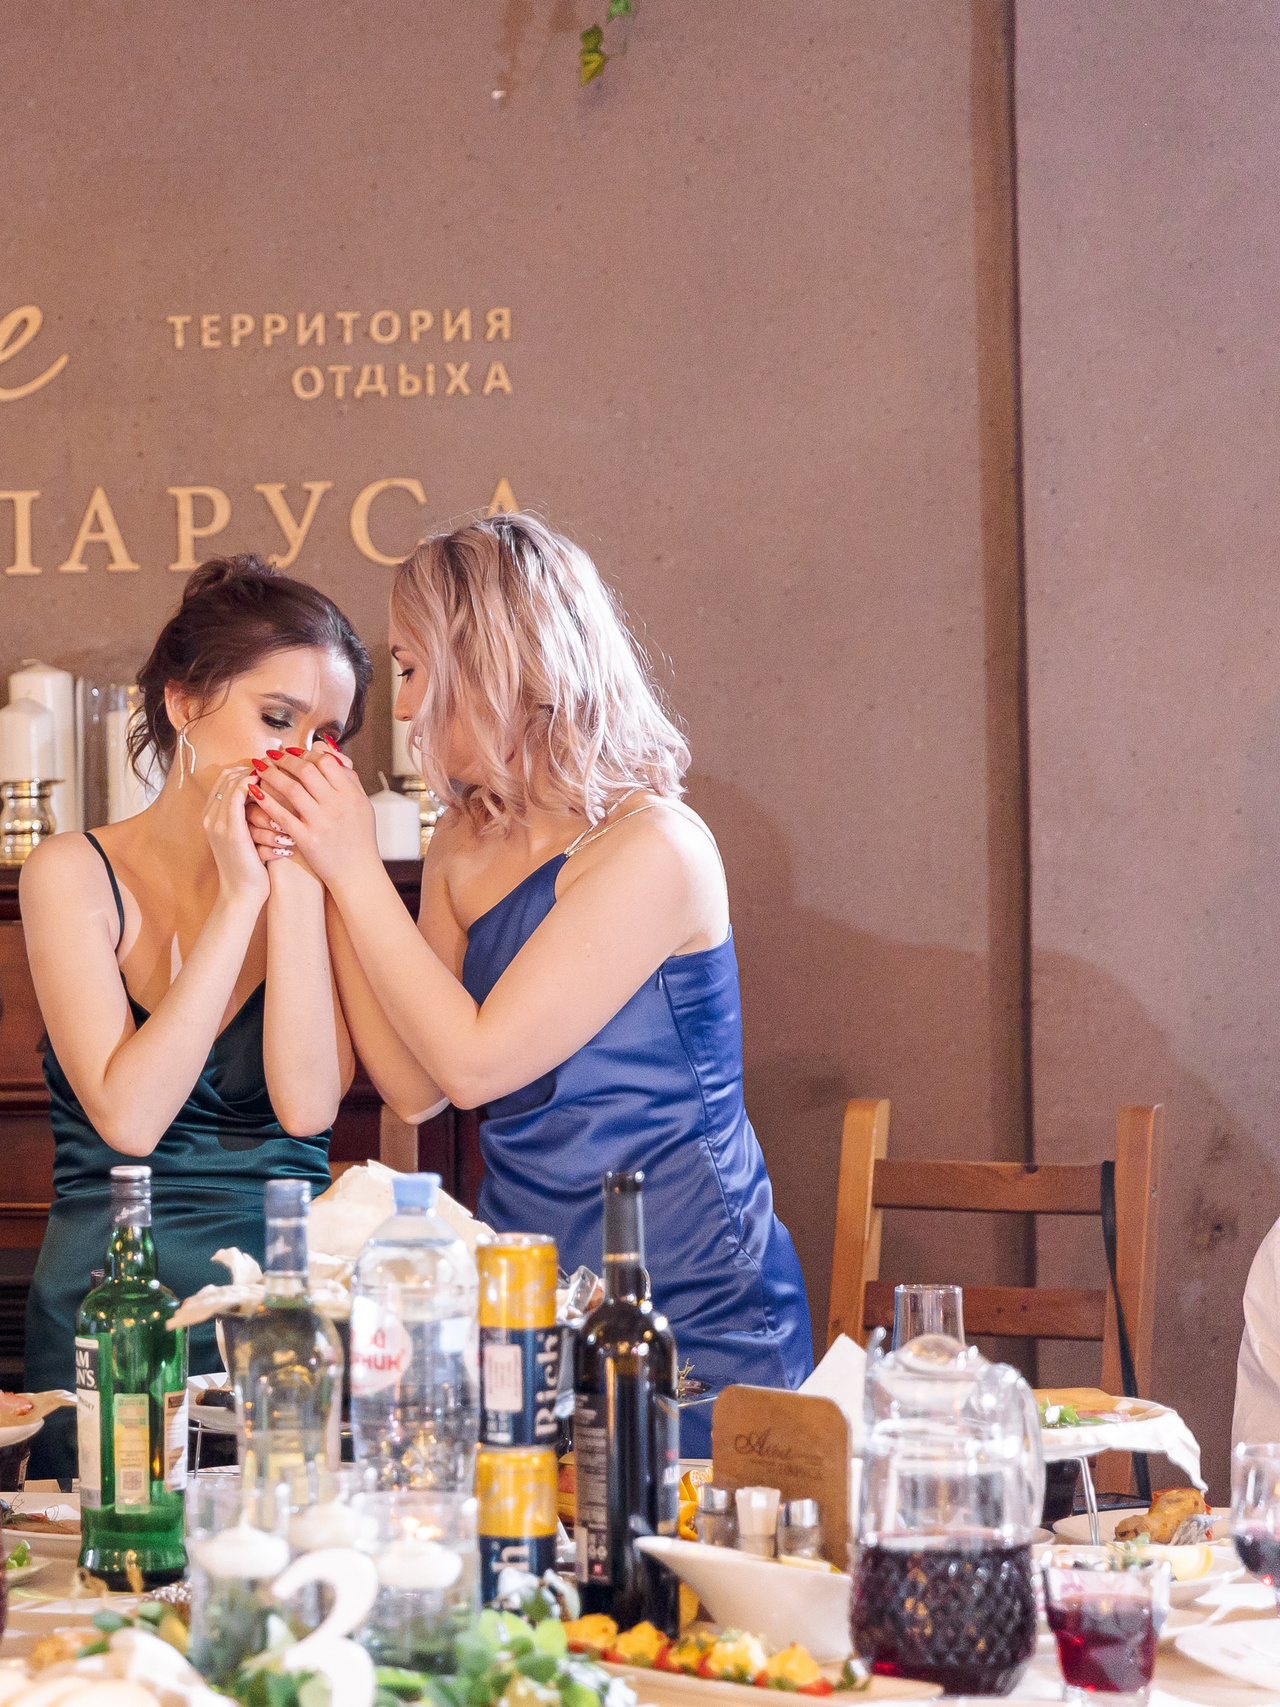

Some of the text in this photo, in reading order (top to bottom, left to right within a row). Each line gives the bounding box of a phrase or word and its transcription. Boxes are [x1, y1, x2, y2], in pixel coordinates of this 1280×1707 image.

[166, 306, 513, 349] ТЕРРИТОРИЯ
[291, 361, 514, 400] ОТДЫХА
[535, 1333, 560, 1438] Rich
